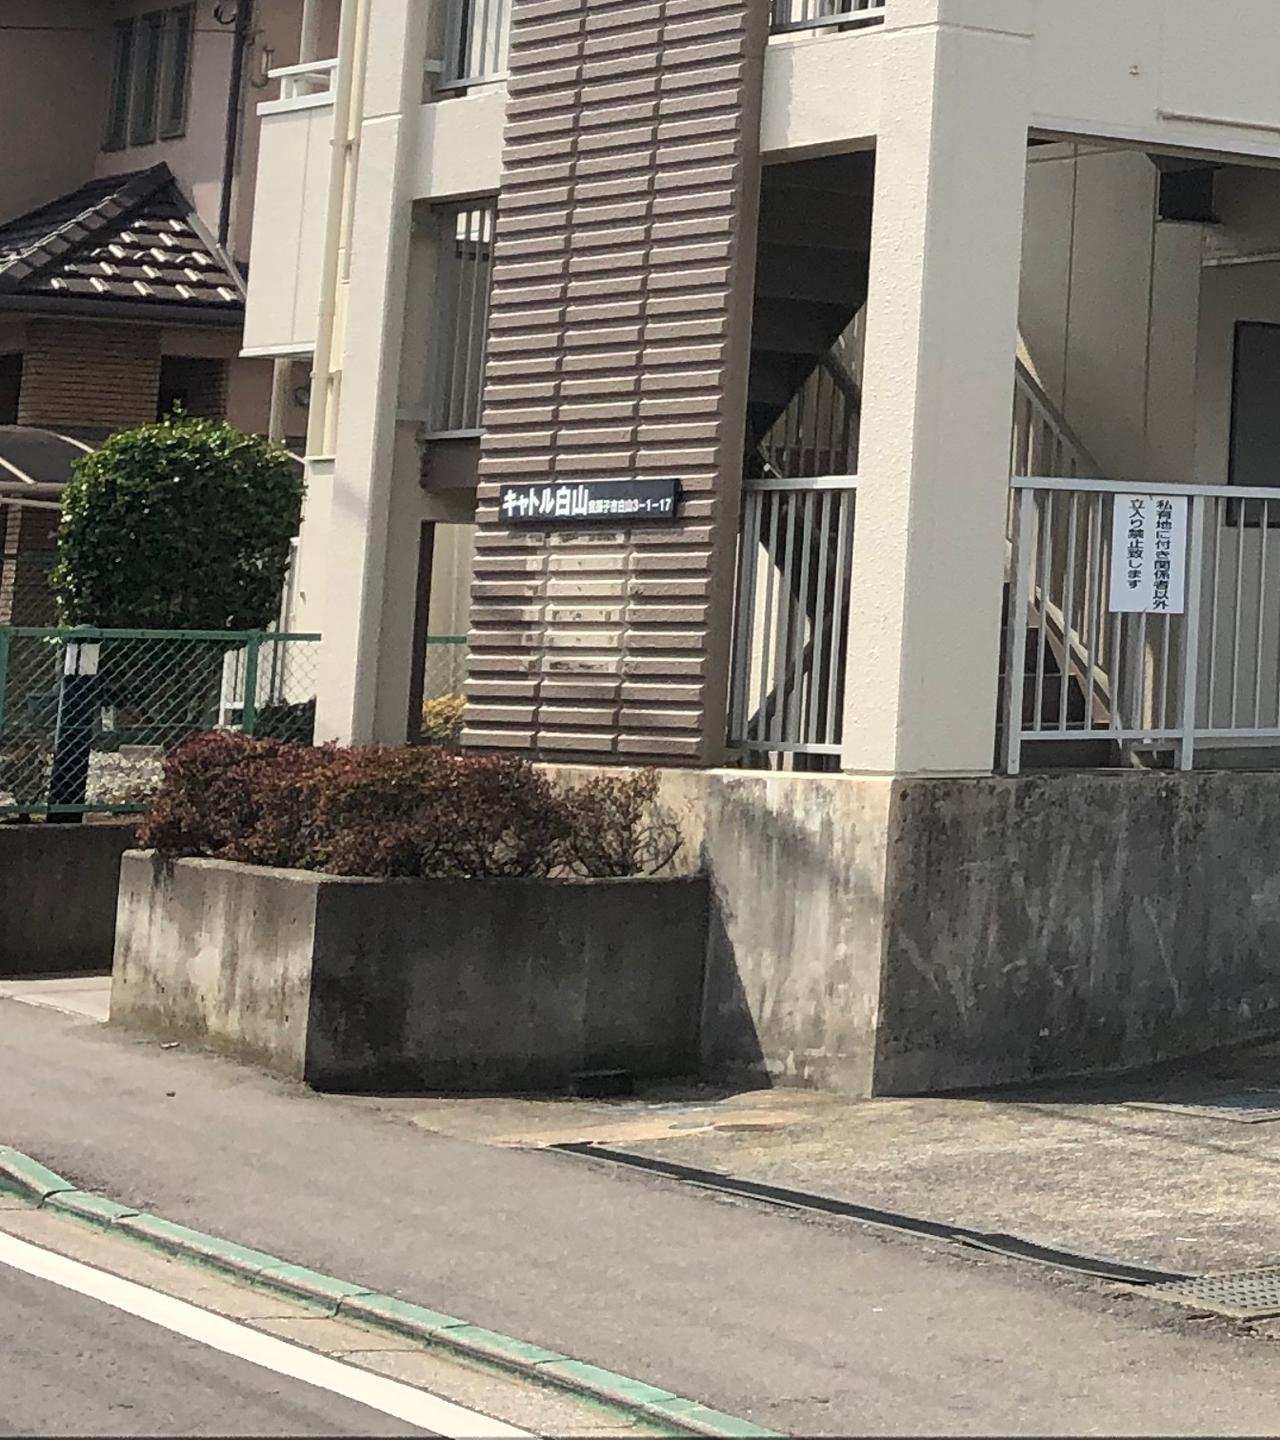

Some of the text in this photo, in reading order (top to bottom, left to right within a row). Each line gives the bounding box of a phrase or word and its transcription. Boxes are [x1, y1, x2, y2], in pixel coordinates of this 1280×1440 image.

[502, 485, 590, 517] キャトル白山
[1127, 498, 1145, 590] 立入り禁止致します
[1152, 499, 1173, 610] 私有地に付き関係者以外
